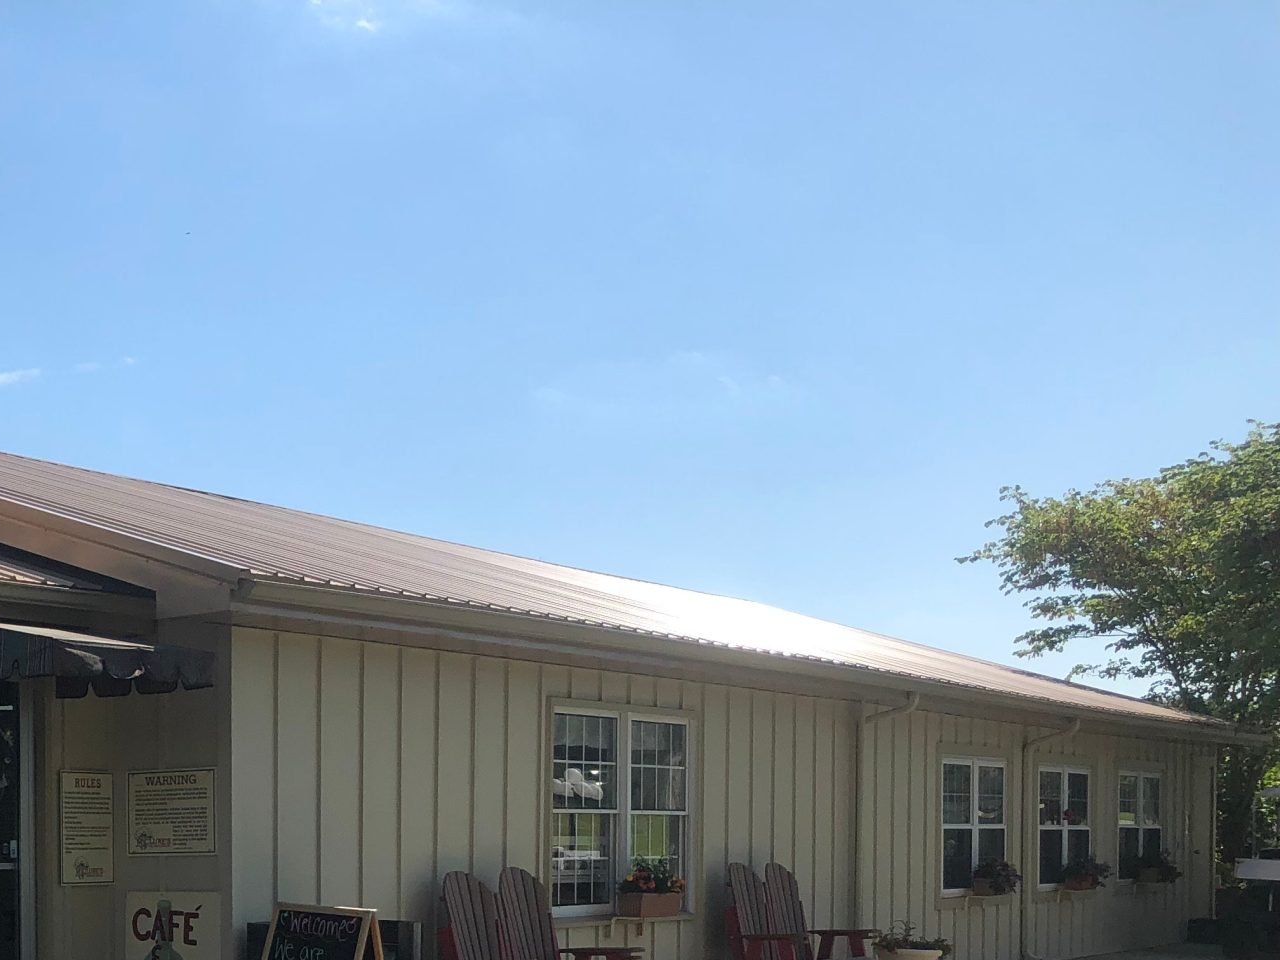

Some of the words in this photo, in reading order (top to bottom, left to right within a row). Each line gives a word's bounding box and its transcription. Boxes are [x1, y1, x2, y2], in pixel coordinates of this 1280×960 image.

[74, 778, 101, 788] RULES
[145, 775, 197, 786] WARNING
[132, 904, 203, 946] CAFÉ
[290, 911, 347, 941] Welcome
